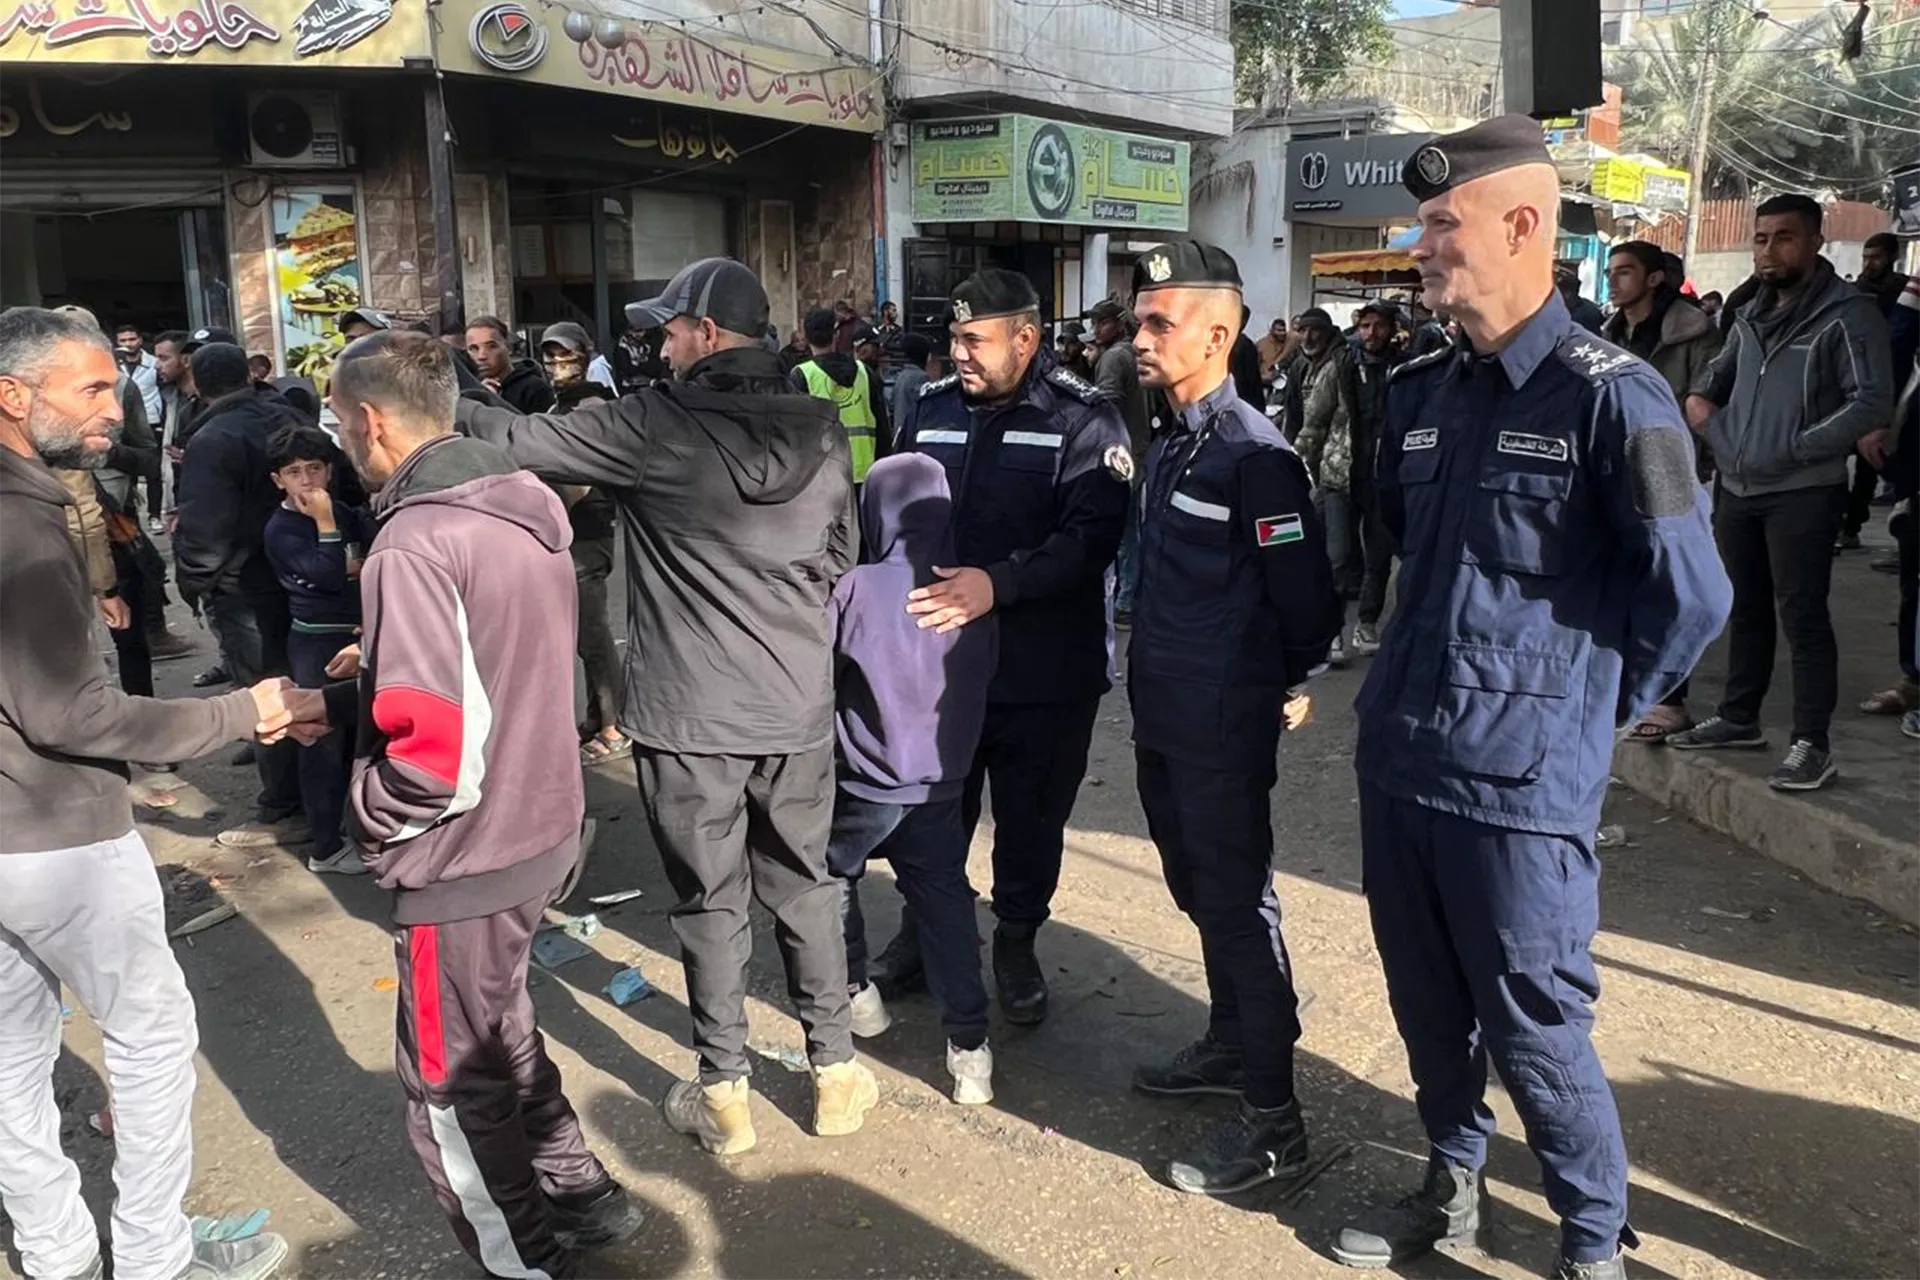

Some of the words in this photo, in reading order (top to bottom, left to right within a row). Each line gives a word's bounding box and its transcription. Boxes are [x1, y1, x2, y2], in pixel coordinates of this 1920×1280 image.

[46, 0, 280, 51] حلويات
[784, 68, 879, 120] حلويات
[919, 146, 1009, 188] حسام
[1081, 139, 1184, 209] حسام
[1344, 159, 1405, 185] Whit
